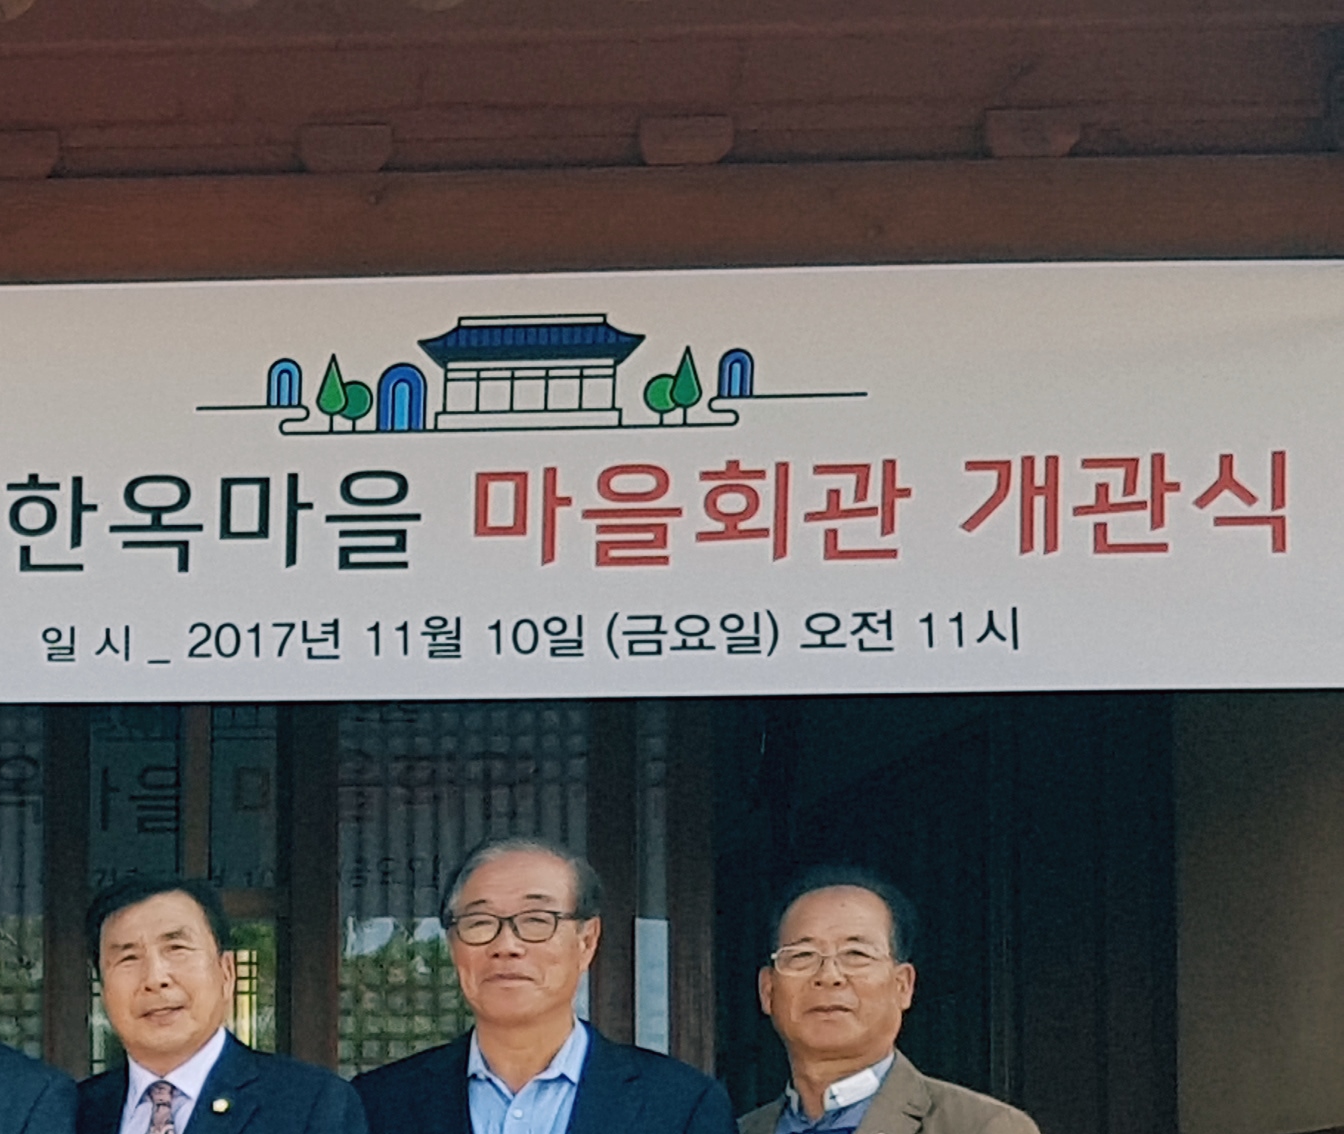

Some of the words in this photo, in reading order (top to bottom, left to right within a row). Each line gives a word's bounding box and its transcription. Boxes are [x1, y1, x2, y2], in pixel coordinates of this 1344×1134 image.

[472, 459, 913, 567] 마을회관
[960, 450, 1288, 554] 개관식
[187, 618, 340, 661] 2017년
[365, 615, 463, 660] 11월
[487, 614, 586, 659] 10일
[605, 609, 780, 660] (금요일)
[799, 610, 896, 654] 오전
[918, 606, 1020, 652] 11시
